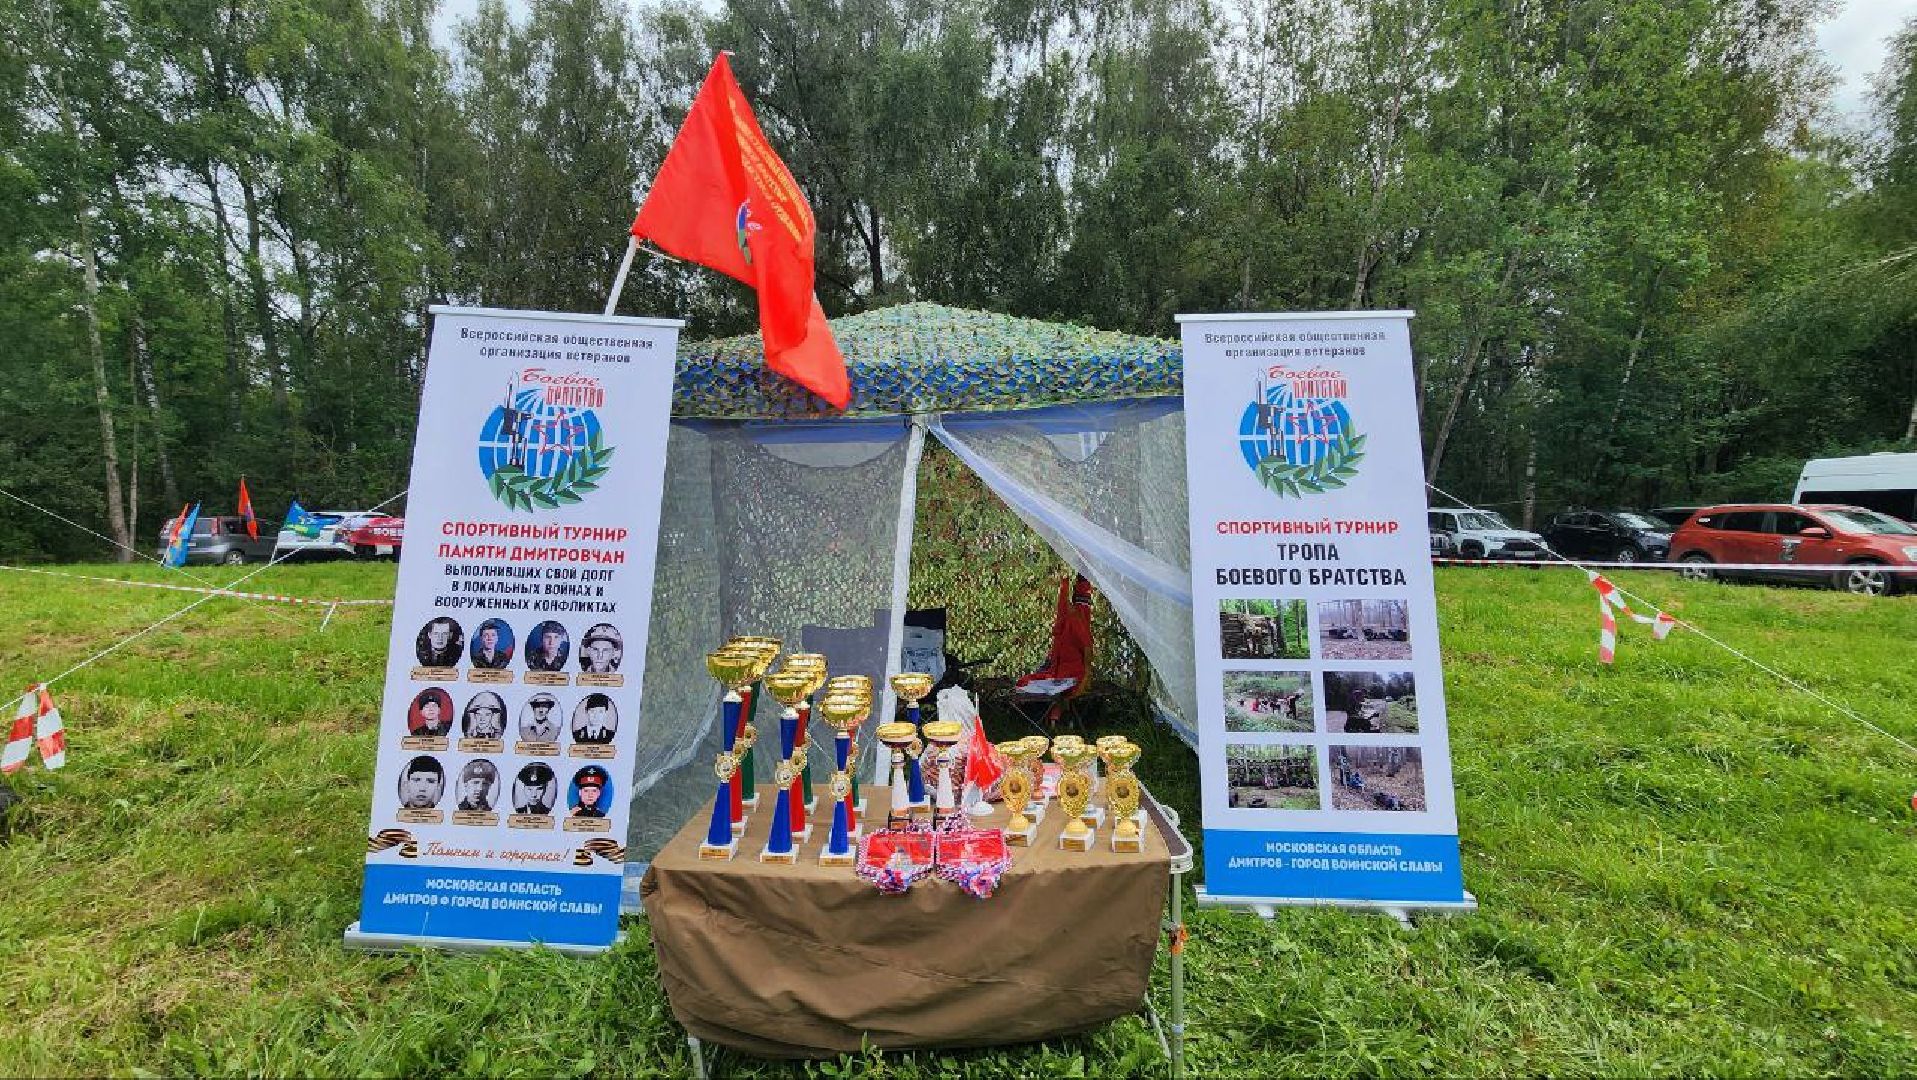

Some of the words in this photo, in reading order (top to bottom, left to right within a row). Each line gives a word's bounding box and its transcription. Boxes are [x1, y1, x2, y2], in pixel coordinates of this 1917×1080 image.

[461, 327, 559, 344] Всероссийская
[563, 333, 653, 350] общественная
[1204, 331, 1296, 346] Всероссийская
[1298, 331, 1386, 343] общественная
[479, 346, 562, 360] организация
[566, 352, 631, 366] ветеранов
[1225, 346, 1300, 359] организация
[1304, 346, 1366, 359] ветеранов
[442, 521, 559, 540] СПОРТИВНЫЙ
[563, 526, 628, 542] ТУРНИР
[1216, 517, 1332, 535] СПОРТИВНЫЙ
[1335, 521, 1399, 535] ТУРНИР
[438, 543, 507, 559] ПАМЯТИ
[510, 545, 626, 564] ДМИТРОВЧАН
[1277, 542, 1340, 561] ТРОПА
[445, 563, 542, 579] ВЫПОЛНИВШИХ
[545, 566, 577, 580] СВОЙ
[581, 569, 615, 582] ДОЛГ
[1216, 568, 1302, 586] БОЕВОГО
[1308, 568, 1407, 586] БРАТСТВА
[451, 580, 460, 592] В
[462, 580, 541, 595] ЛОКАЛЬНЫХ
[544, 581, 592, 597] ВОЙНАХ
[595, 585, 604, 597] И
[434, 595, 531, 610] ВООРУЖЕННЫХ
[533, 598, 617, 613] КОНФЛИКТАХ
[1265, 841, 1347, 854] МОСКОВСКАЯ
[1348, 843, 1402, 856] ОБЛАСТЬ
[1228, 855, 1283, 869] ДМИТРОВ
[1291, 858, 1330, 871] ГОРОД
[1331, 857, 1398, 872] ВОИНСКОЙ
[1399, 860, 1444, 874] СЛАВЫ
[425, 878, 506, 893] МОСКОВСКАЯ
[508, 881, 563, 896] ОБЛАСТЬ
[382, 891, 438, 906] ДМИТРОВ
[451, 896, 489, 911] ГОРОД
[491, 896, 556, 913] ВОИНСКОЙ
[559, 901, 603, 915] СЛАВЫ
